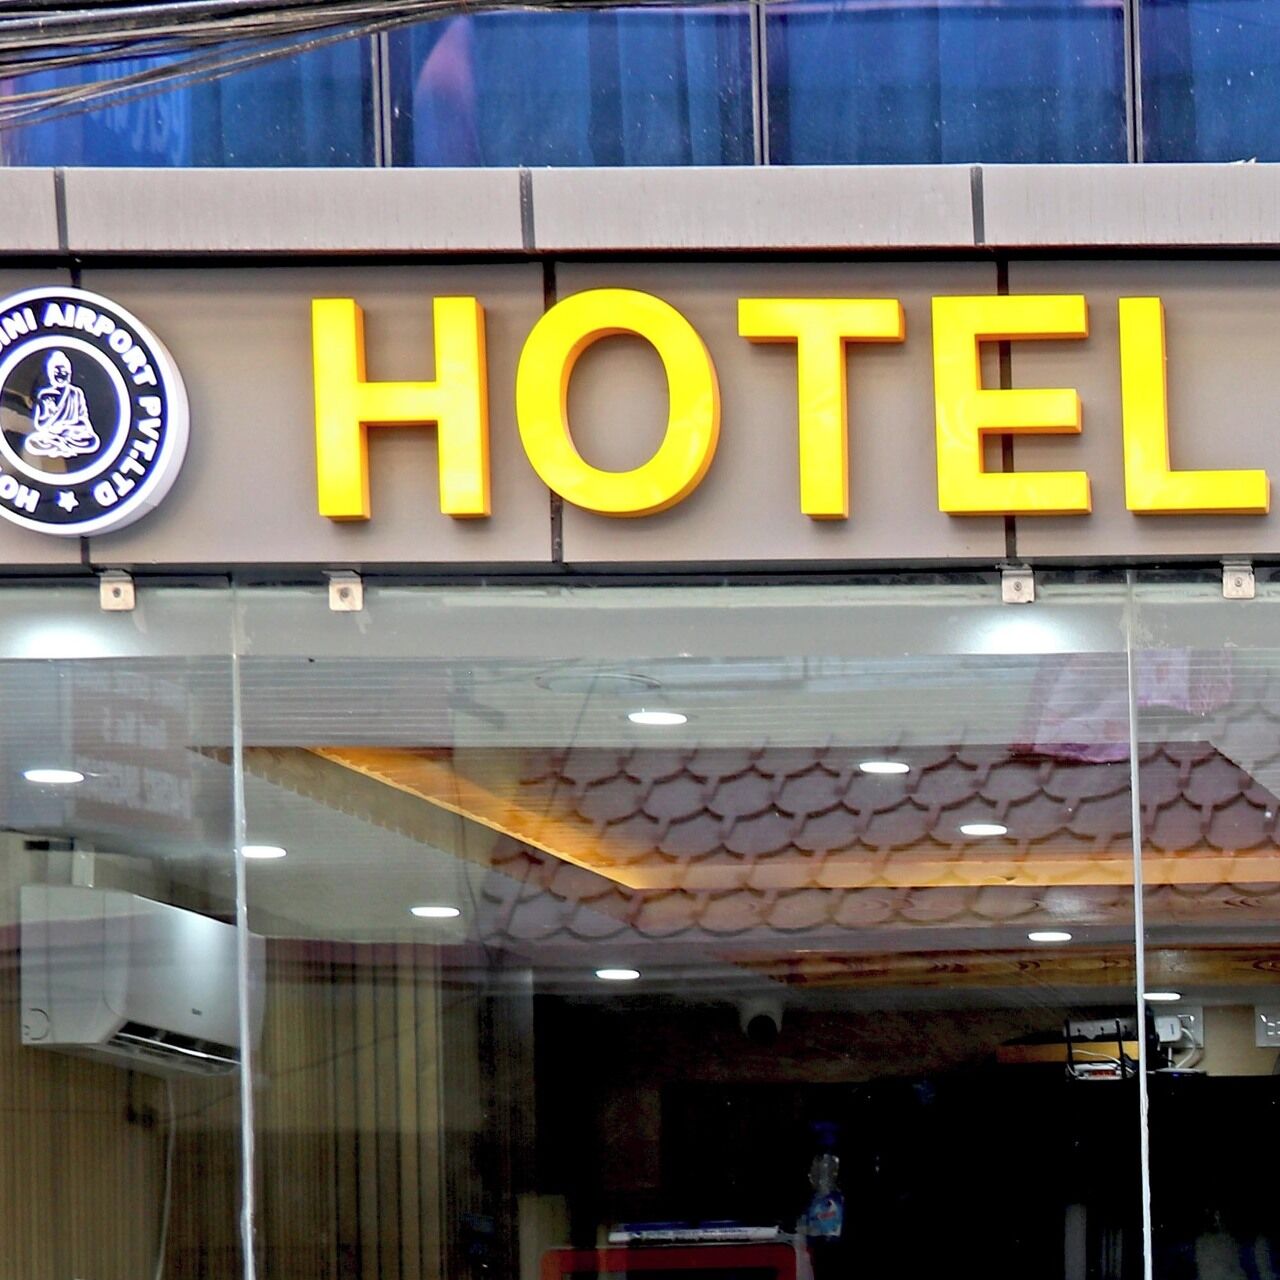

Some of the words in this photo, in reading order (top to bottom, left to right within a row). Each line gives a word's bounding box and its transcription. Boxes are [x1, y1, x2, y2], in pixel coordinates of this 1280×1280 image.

[0, 307, 37, 352] INI
[43, 303, 157, 386] AIRPORT
[310, 287, 1271, 522] HOTEL
[0, 466, 41, 513] HO
